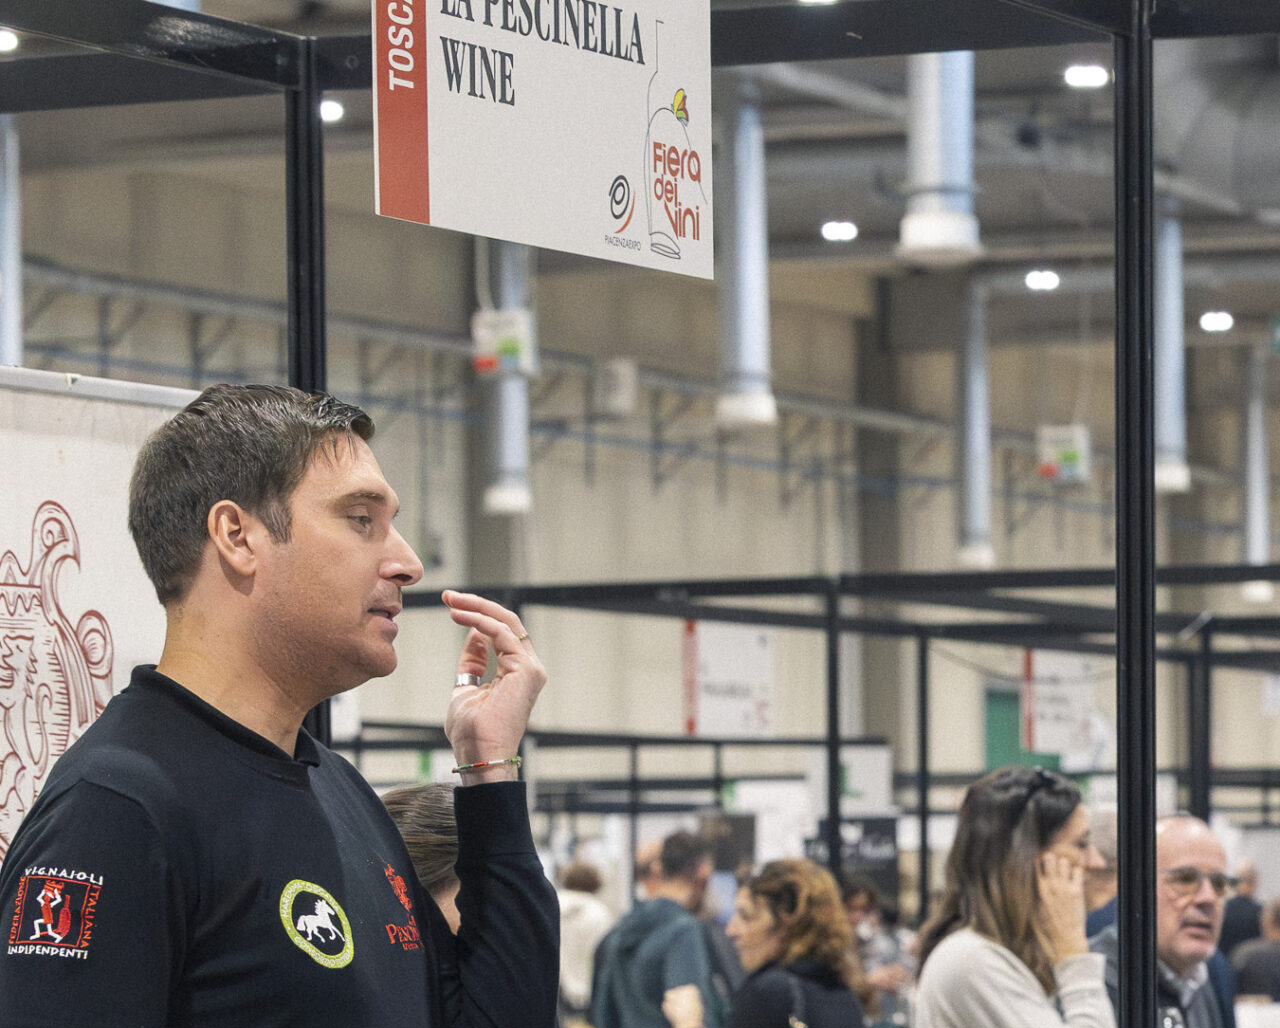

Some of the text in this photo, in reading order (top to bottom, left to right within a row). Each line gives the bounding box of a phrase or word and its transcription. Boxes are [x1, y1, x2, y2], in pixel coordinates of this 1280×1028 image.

[388, 0, 415, 91] TOSC
[439, 35, 515, 107] WINE
[653, 141, 701, 183] Fiera
[653, 172, 679, 209] dei
[24, 866, 104, 886] VIGNAIOLI
[8, 876, 26, 944] FEDERAZIONE
[80, 884, 102, 948] ITALIANA
[7, 945, 89, 960] INDIPENDENTI
